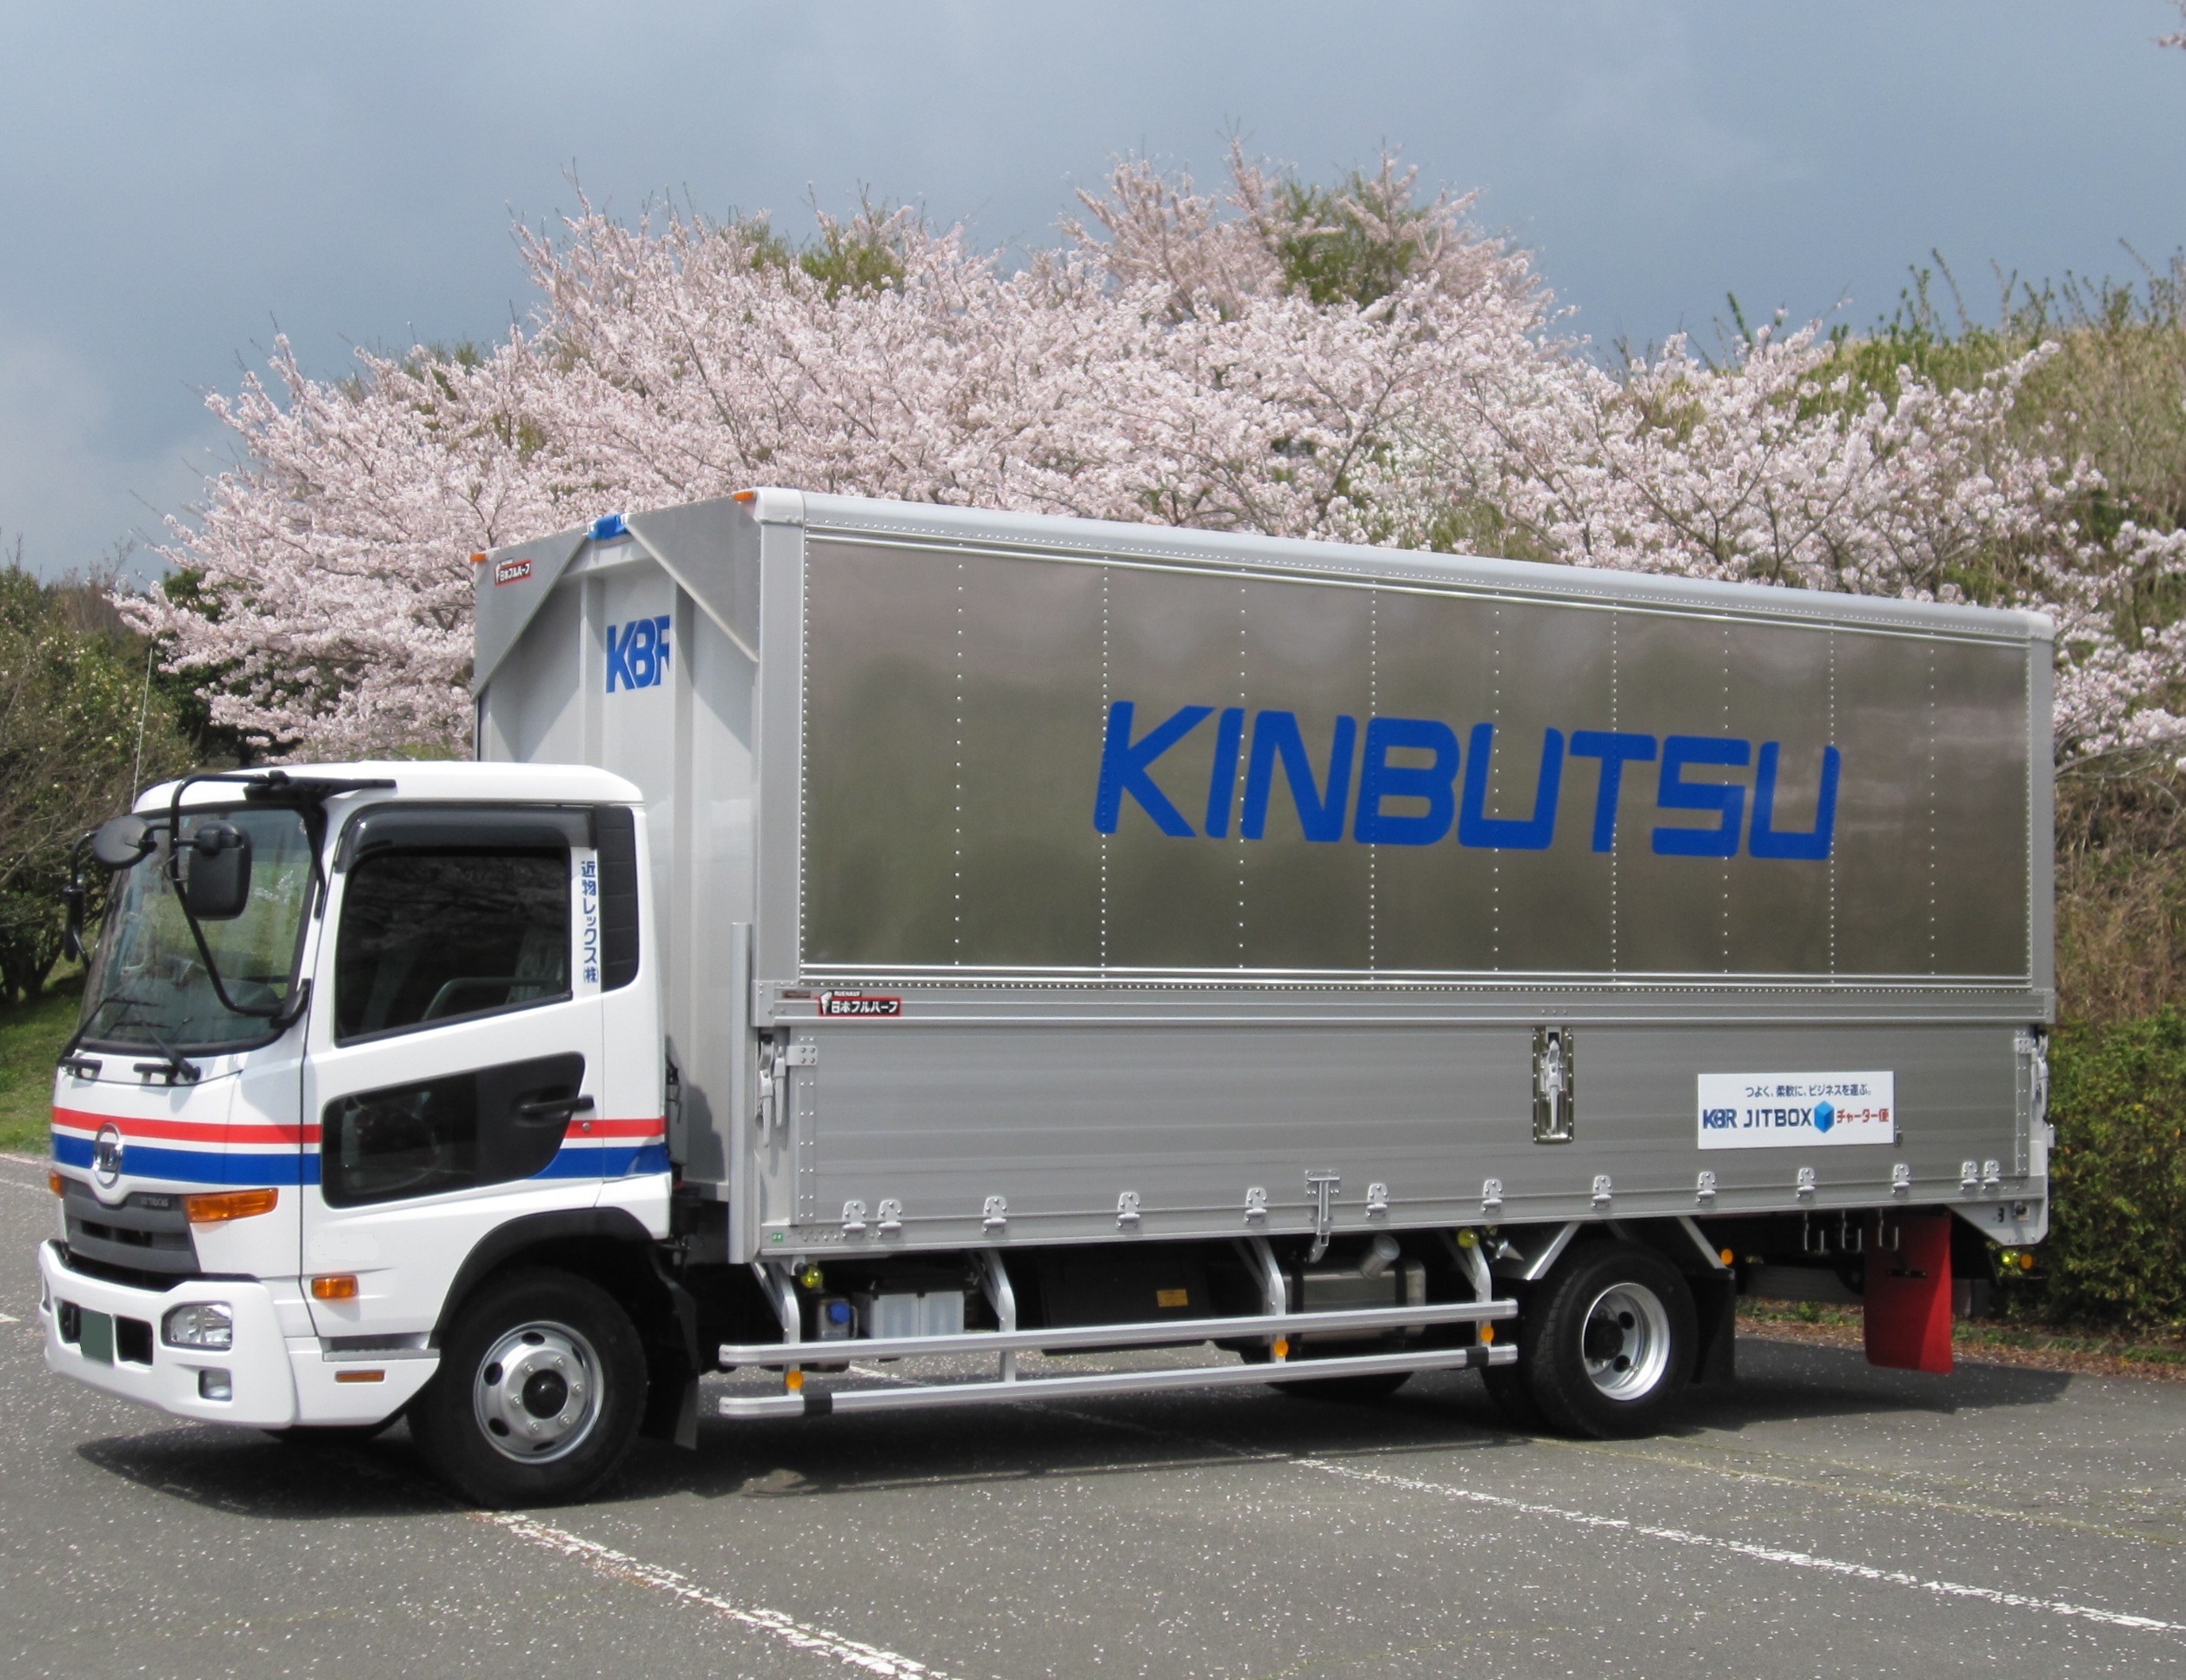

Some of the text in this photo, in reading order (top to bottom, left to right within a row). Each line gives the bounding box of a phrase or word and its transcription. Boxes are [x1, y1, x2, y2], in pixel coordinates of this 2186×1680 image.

[1093, 701, 1841, 860] KINBUTSU
[831, 1000, 899, 1013] 日本フルハーフ
[1703, 1107, 1890, 1129] KBR JITBOX チャーター便
